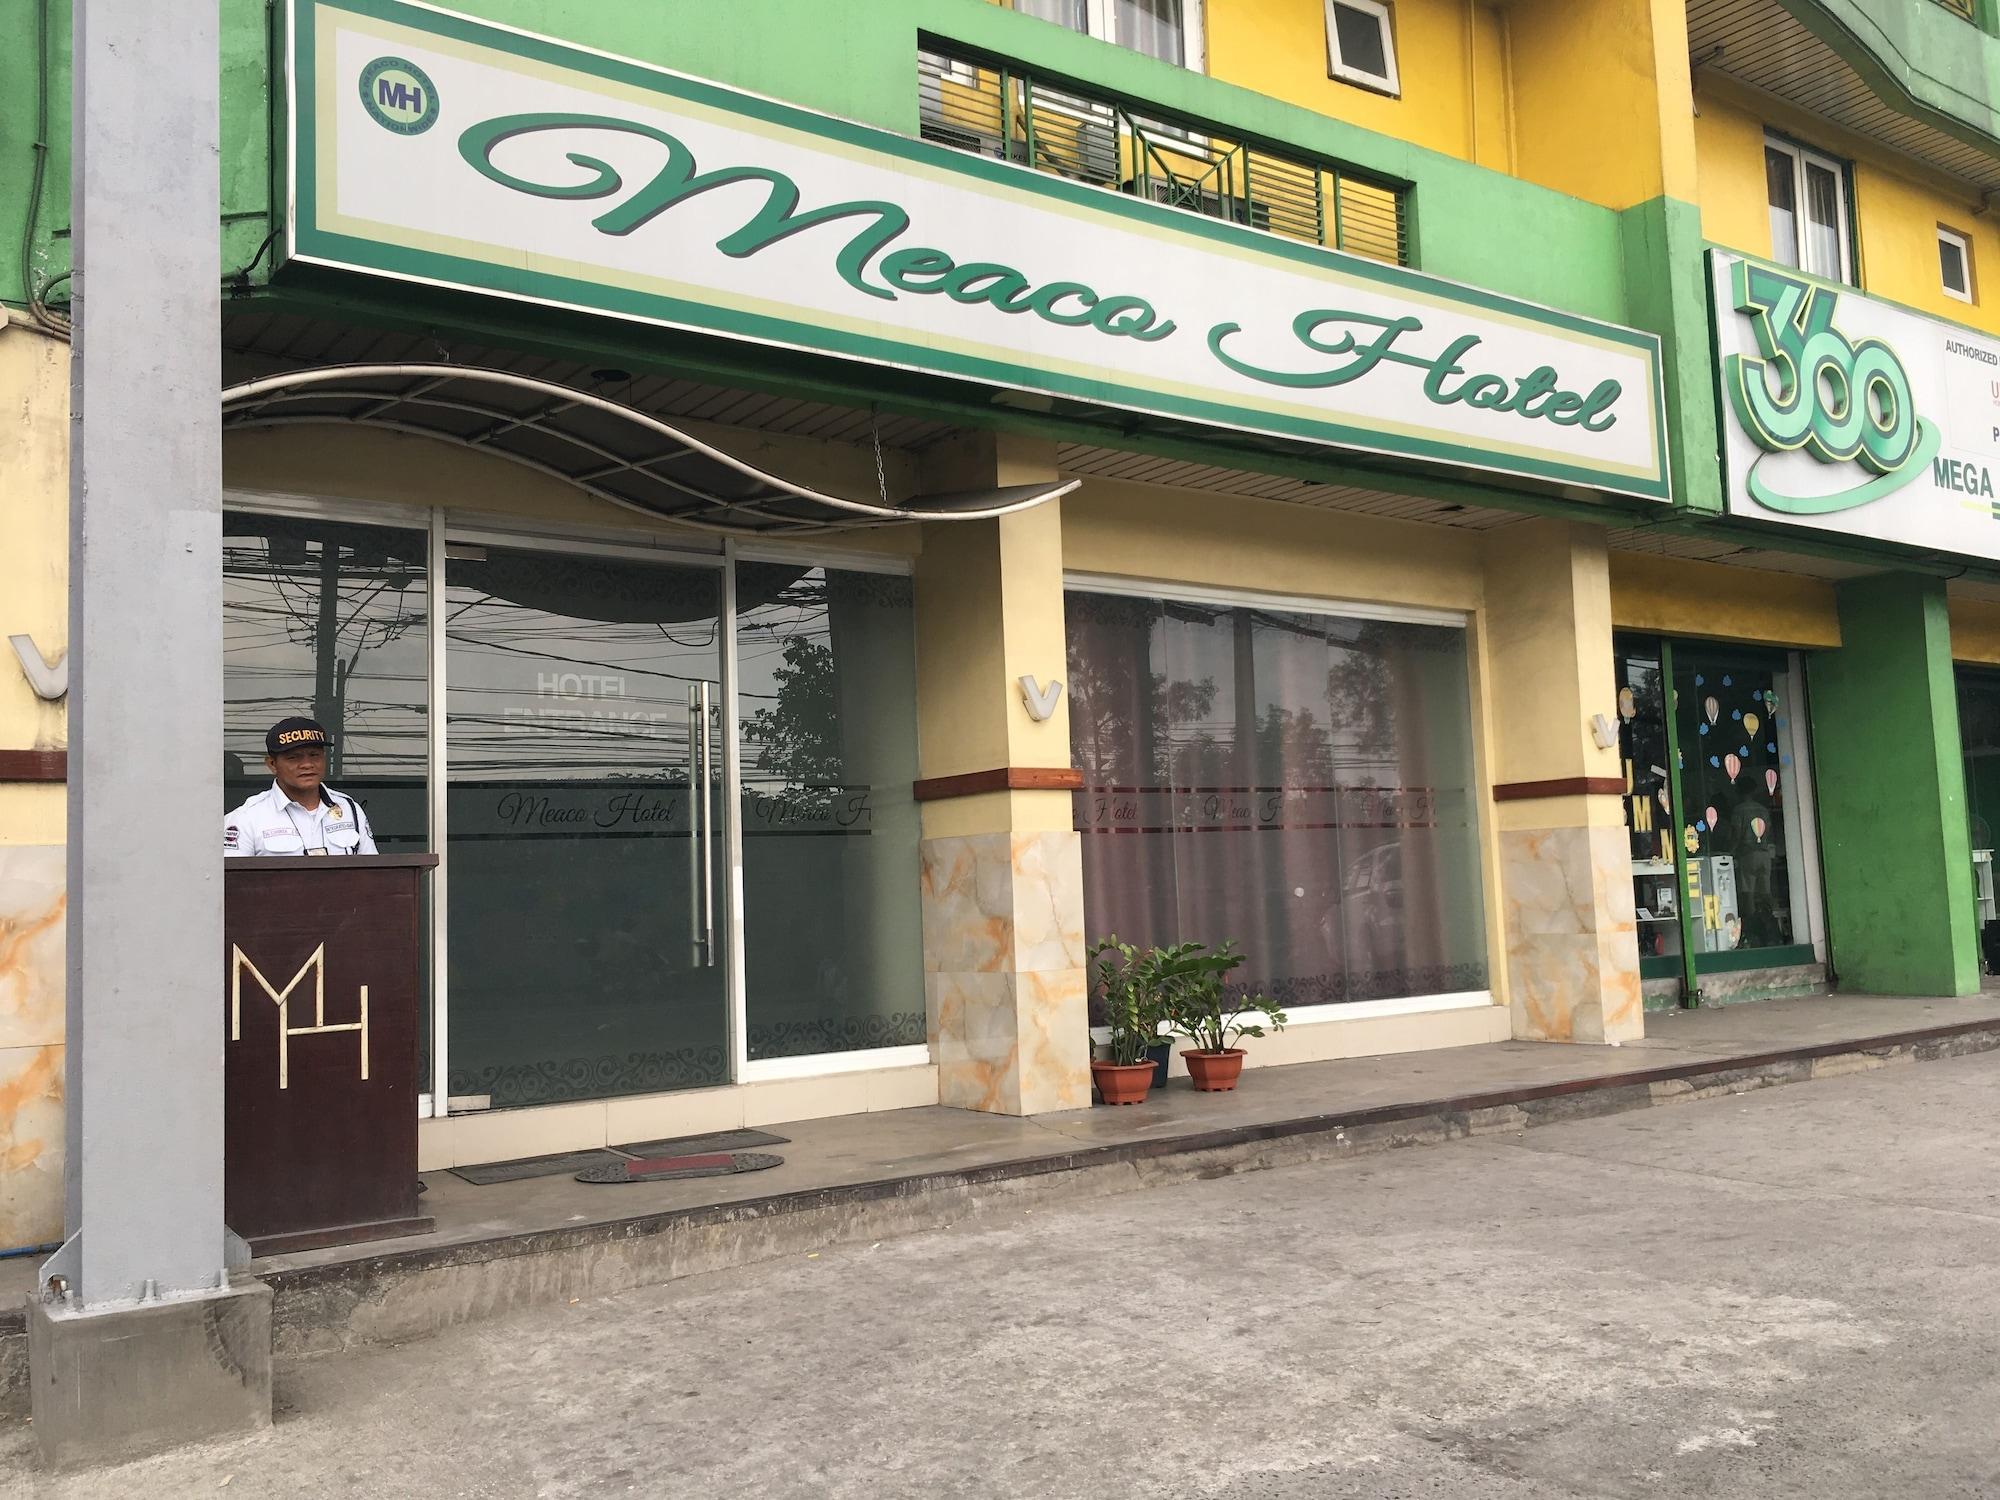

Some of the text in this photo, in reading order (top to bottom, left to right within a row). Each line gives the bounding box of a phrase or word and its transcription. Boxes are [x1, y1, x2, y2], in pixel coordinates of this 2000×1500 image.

[378, 78, 421, 114] MH
[457, 112, 1622, 433] Meaco Hotel
[1724, 258, 1917, 474] 360
[1945, 339, 1998, 366] AUTHORIZED
[1933, 456, 1994, 499] MEGA
[537, 672, 635, 703] HOTEL
[278, 729, 325, 745] SECURITY
[503, 707, 669, 739] ENTRANCE
[497, 792, 677, 828] Meaco Hotel
